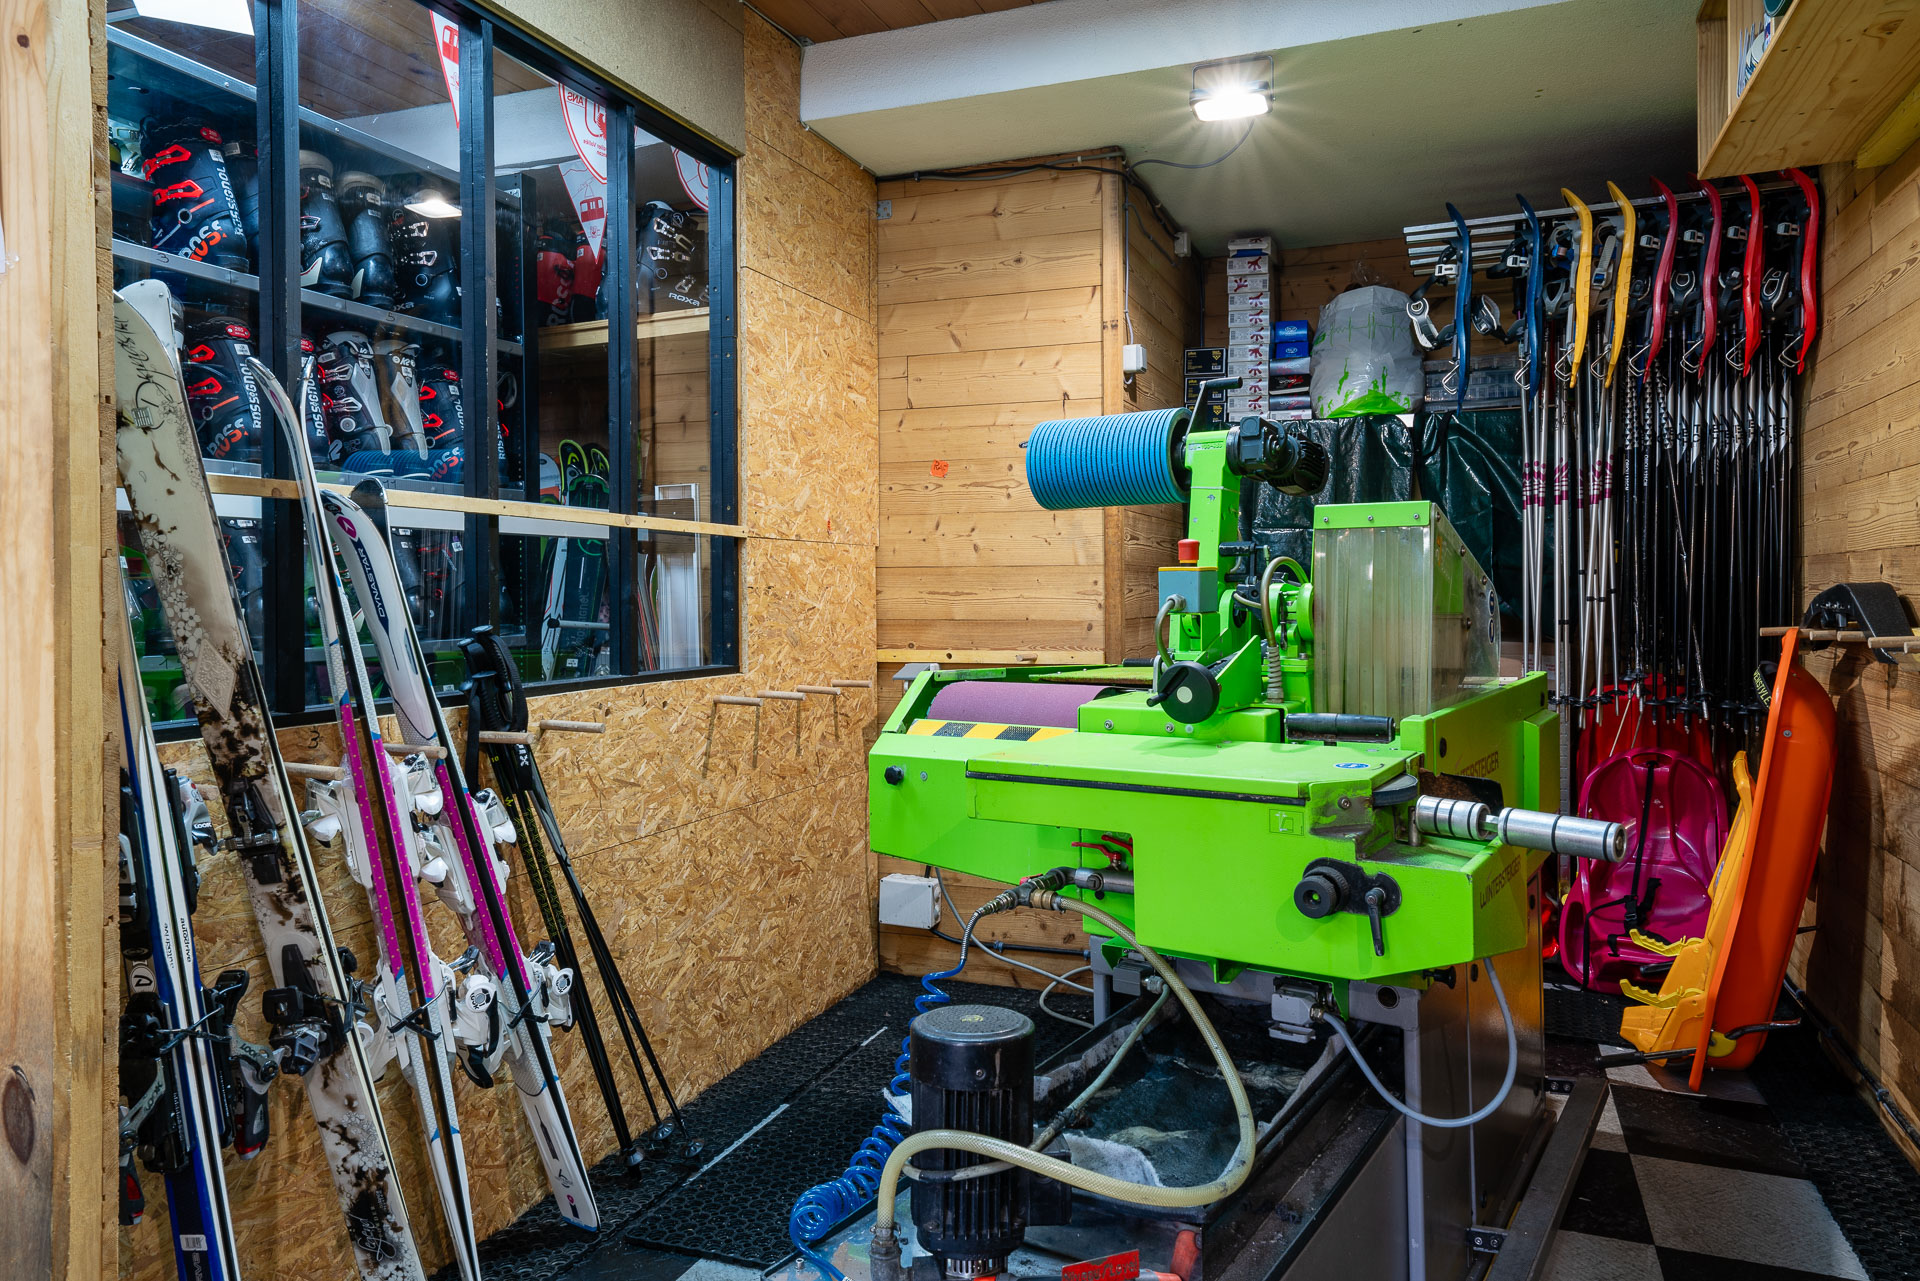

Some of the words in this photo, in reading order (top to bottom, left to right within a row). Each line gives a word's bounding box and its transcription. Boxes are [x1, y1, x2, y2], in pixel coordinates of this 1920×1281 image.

[385, 312, 396, 322] 5
[357, 547, 386, 618] DYNASTAR
[307, 728, 320, 750] 3
